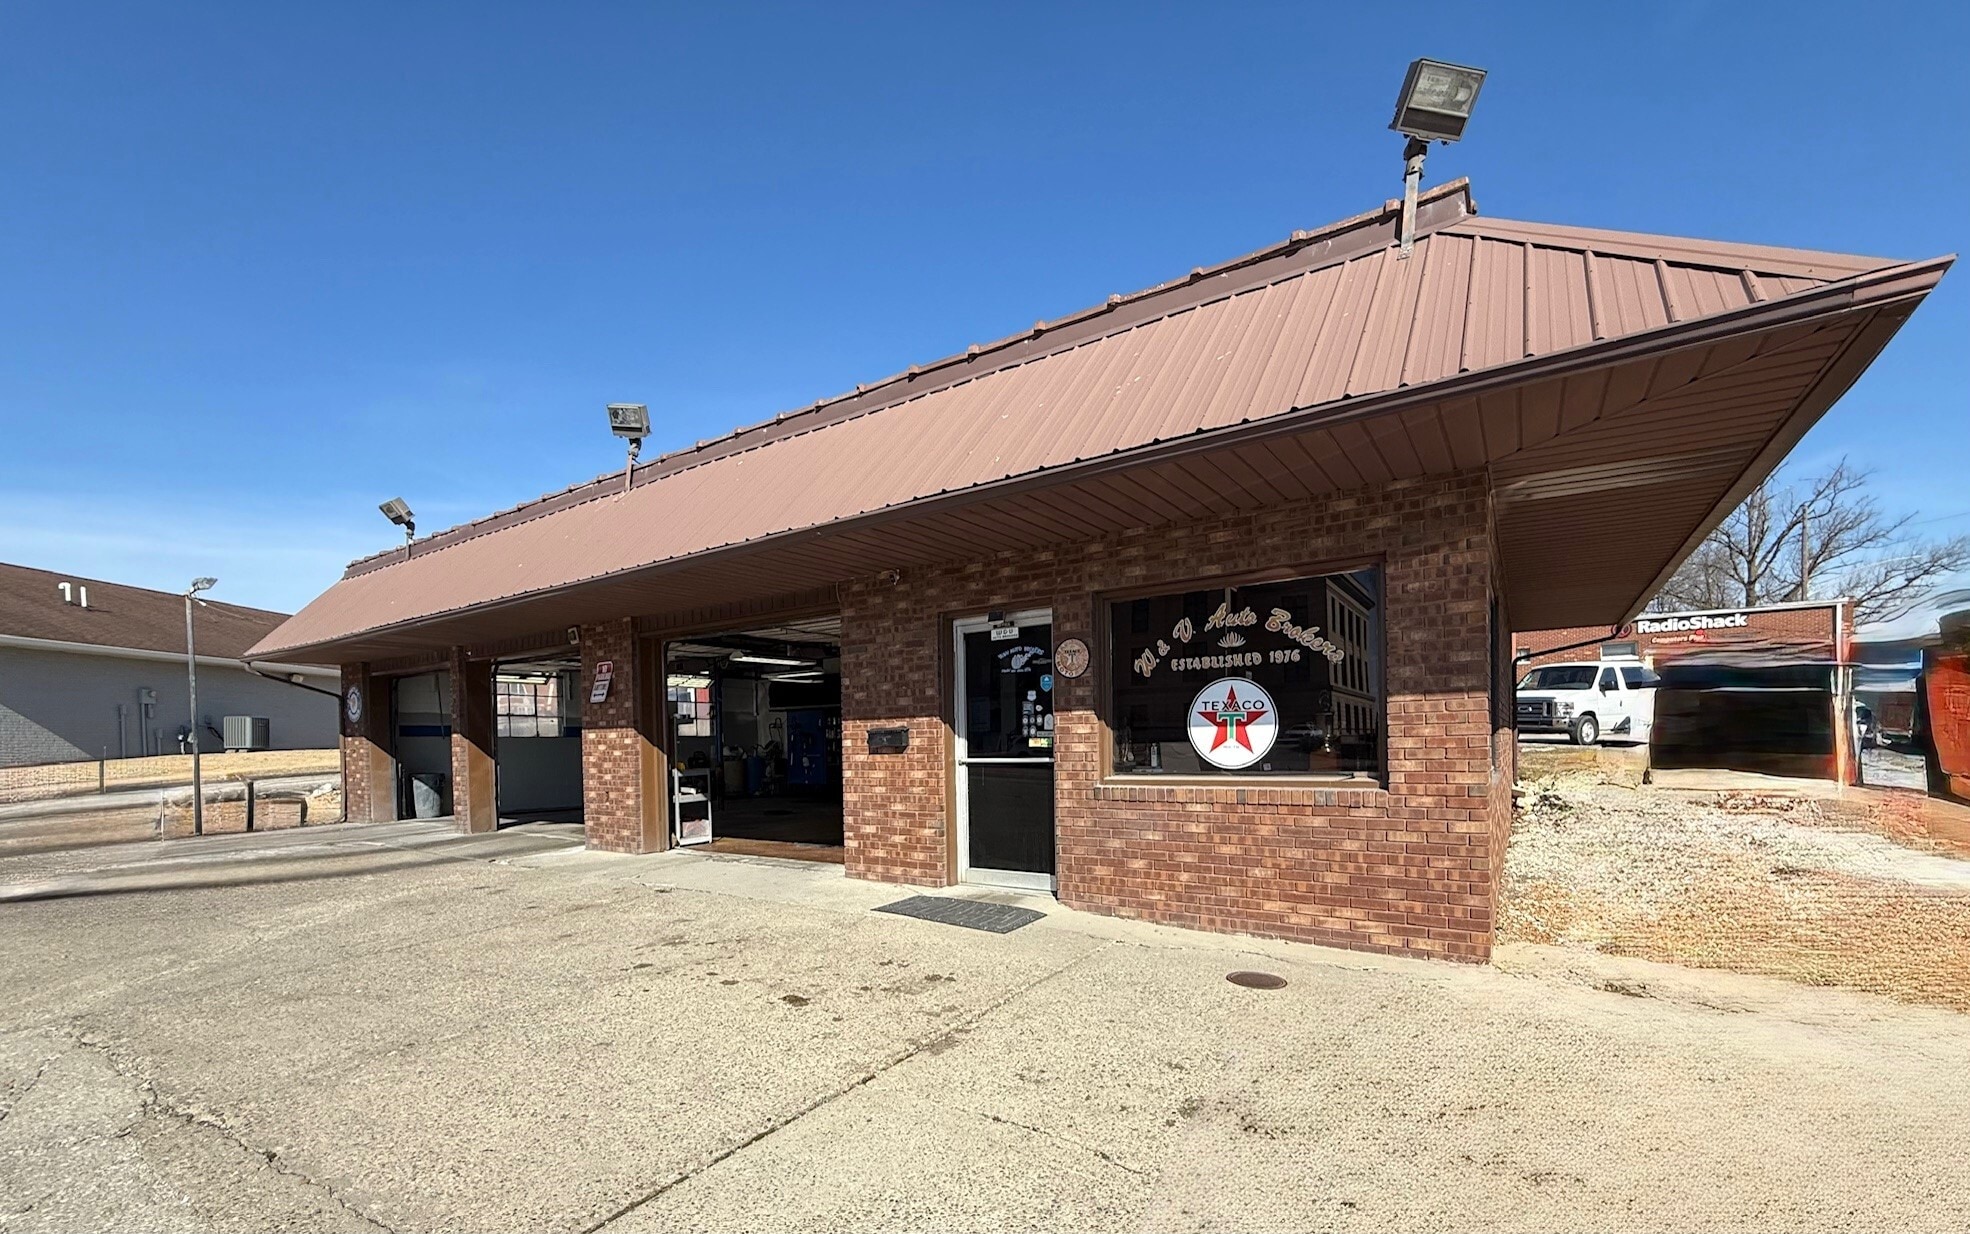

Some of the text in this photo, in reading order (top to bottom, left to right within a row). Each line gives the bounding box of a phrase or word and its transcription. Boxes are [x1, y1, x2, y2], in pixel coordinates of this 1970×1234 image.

[1204, 602, 1258, 632] Auto
[1264, 607, 1345, 665] Brokers
[1637, 613, 1748, 634] RadioShack
[1171, 649, 1301, 672] ESTABLISHED 1976
[1202, 700, 1264, 711] TEXACO
